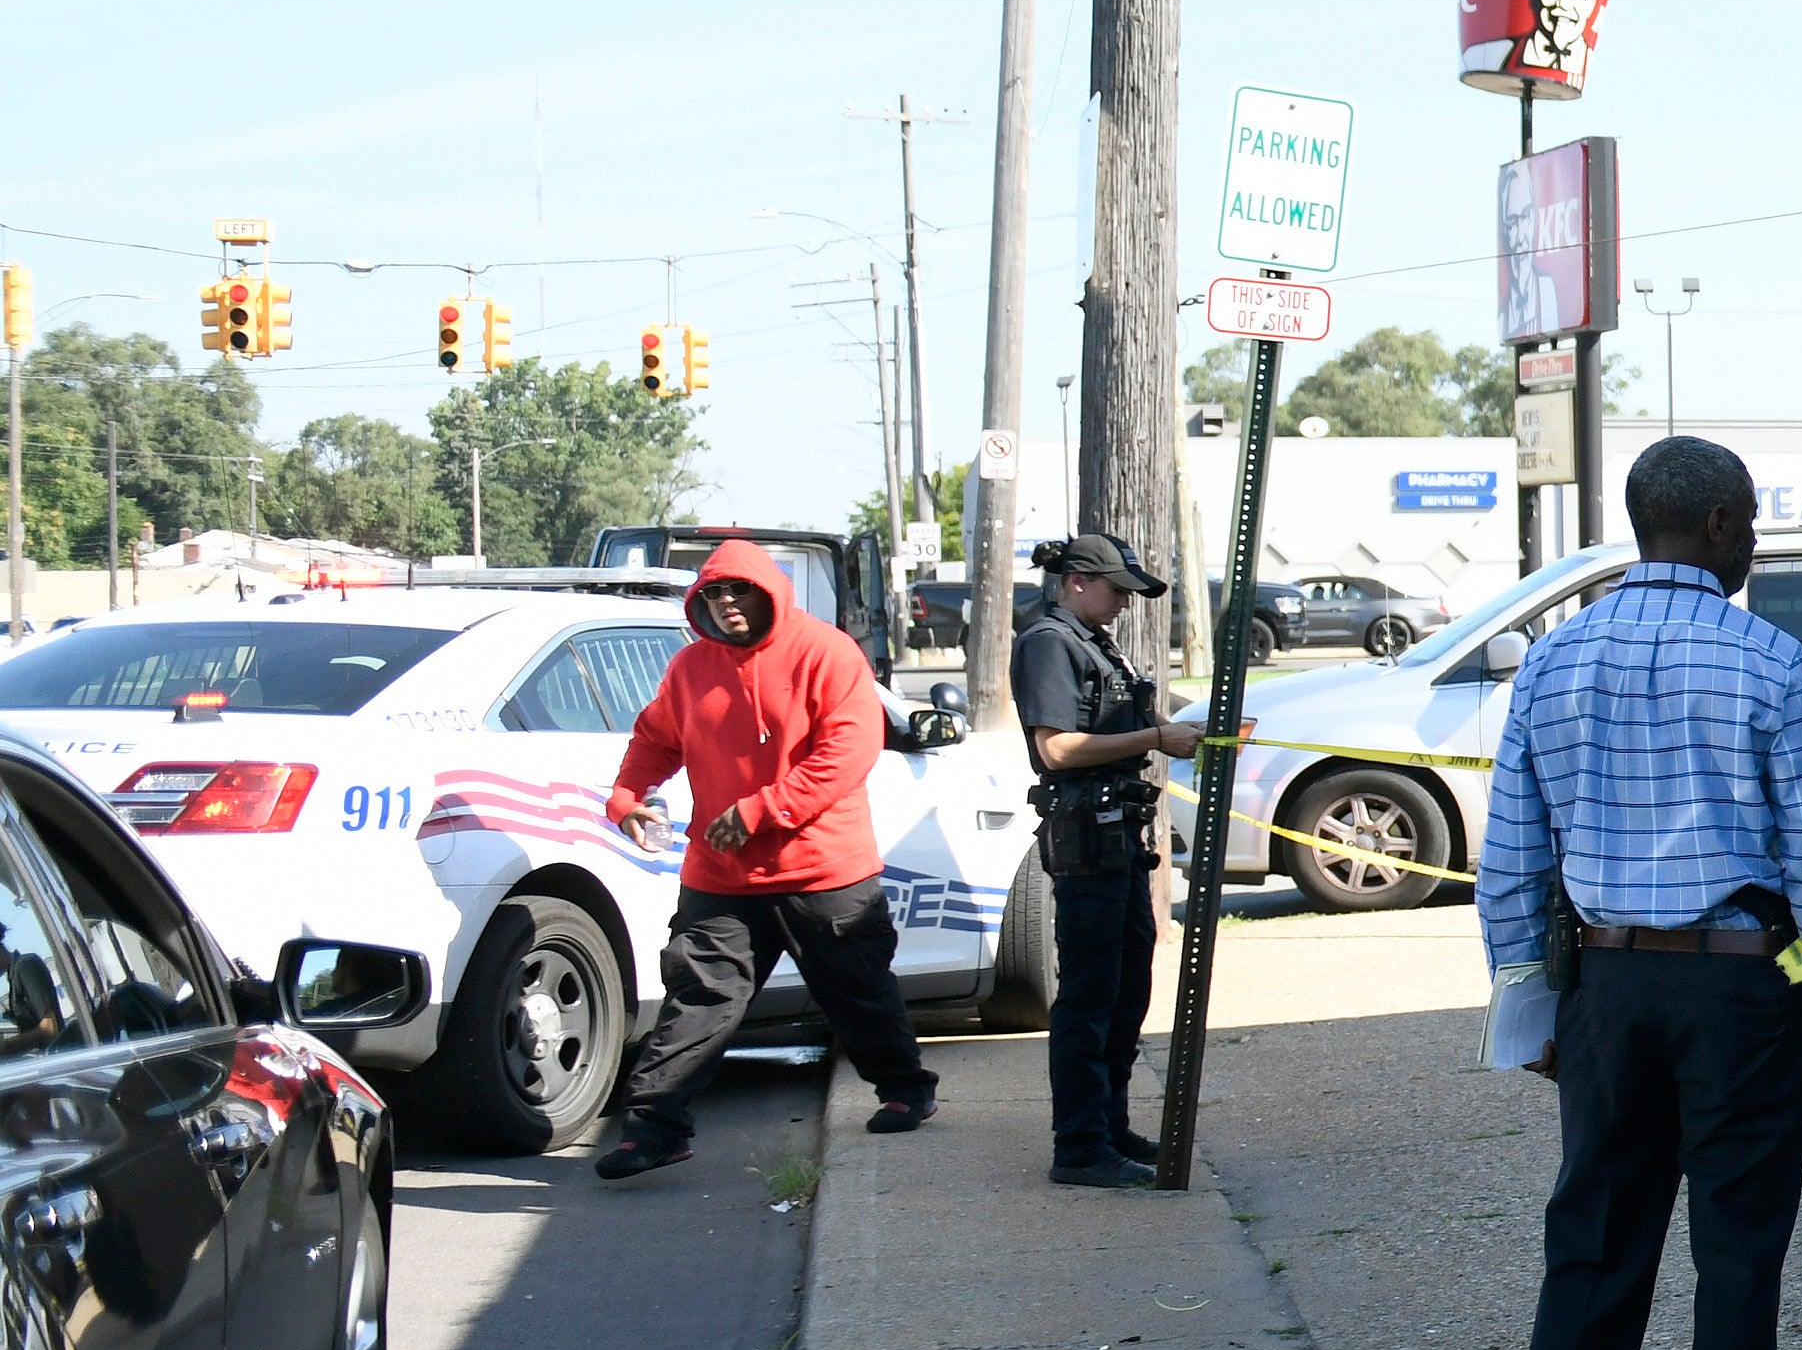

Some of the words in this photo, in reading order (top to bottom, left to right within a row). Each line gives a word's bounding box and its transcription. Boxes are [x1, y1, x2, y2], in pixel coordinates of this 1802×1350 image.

[1238, 126, 1341, 168] PARKING
[1228, 191, 1334, 232] ALLOWED
[223, 223, 256, 235] LEFT
[1535, 197, 1579, 257] KFC
[1231, 285, 1263, 306] THIS
[1278, 289, 1311, 310] SIDE
[1237, 310, 1257, 329] OF
[1267, 313, 1302, 333] SIGN
[1408, 472, 1490, 487] PHARMACY
[1420, 494, 1450, 507] DRIVE
[1450, 494, 1479, 507] THRU
[1755, 486, 1795, 520] TE
[912, 543, 937, 557] 30
[43, 741, 138, 755] LICE
[341, 785, 412, 832] 911
